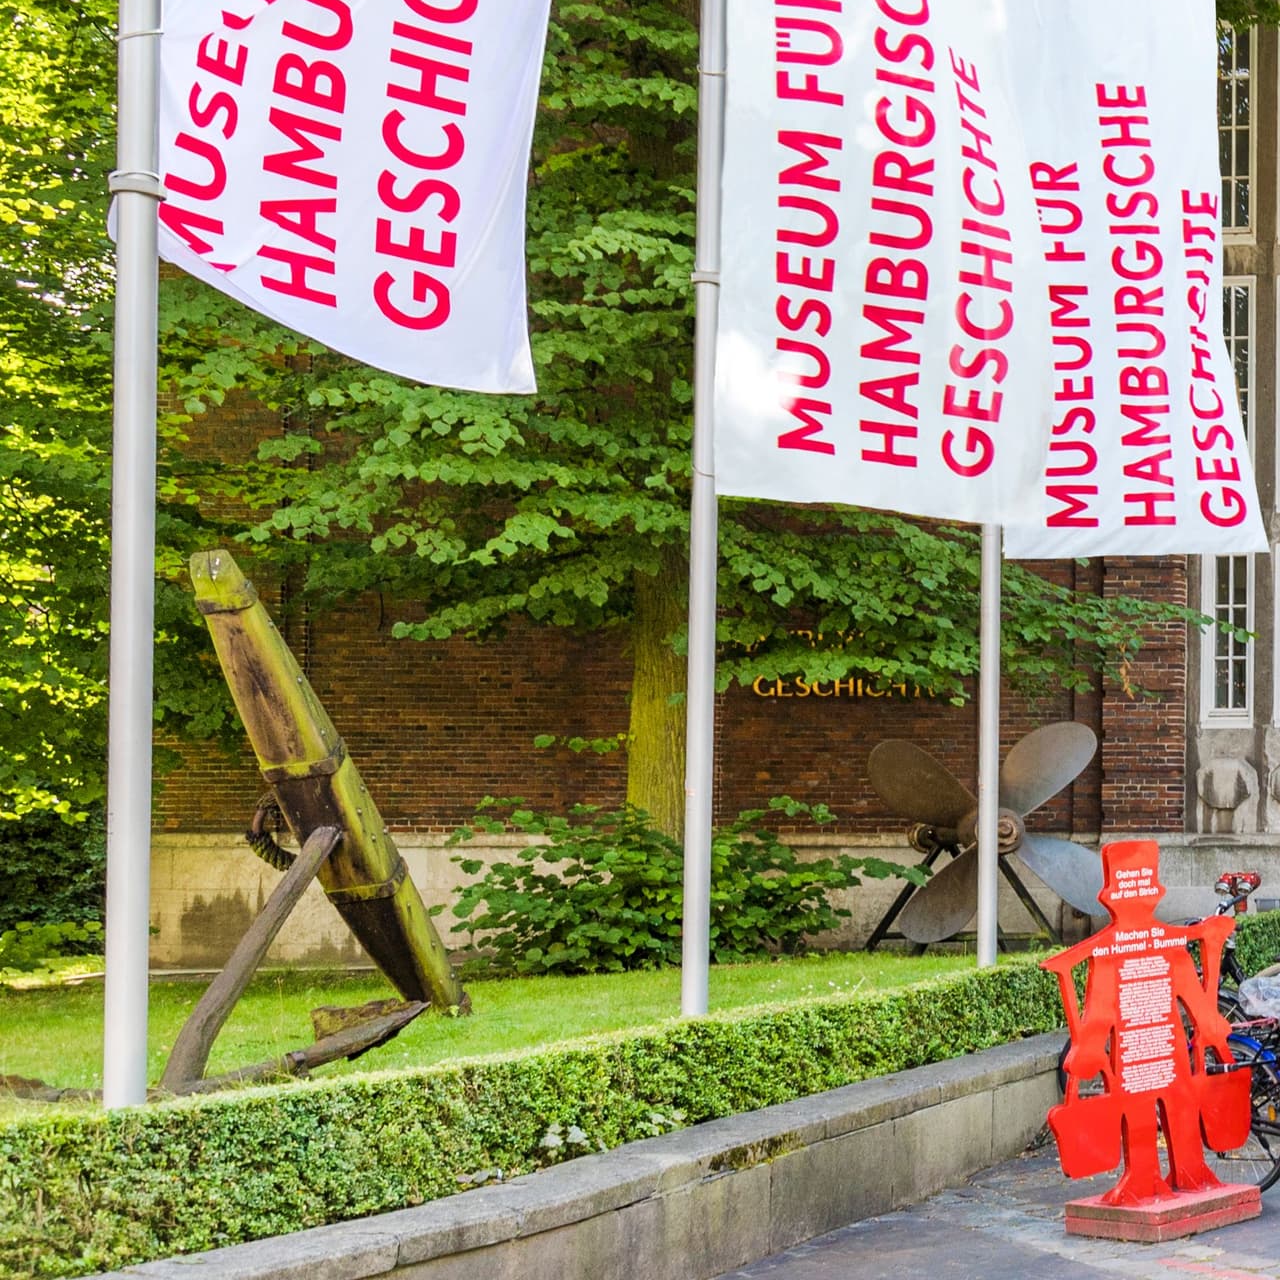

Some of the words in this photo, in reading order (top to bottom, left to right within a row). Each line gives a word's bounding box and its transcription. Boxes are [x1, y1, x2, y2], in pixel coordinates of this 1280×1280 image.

[1029, 161, 1087, 263] FÜR
[942, 46, 1016, 479] GESCHICHTE
[776, 130, 844, 457] MUSEUM
[1096, 83, 1178, 528] HAMBURGISCHE
[1045, 285, 1100, 529] MUSEUM
[753, 674, 935, 697] GESCHICH
[1116, 870, 1140, 879] Gehen
[1141, 868, 1153, 876] Sie
[1119, 880, 1136, 888] doch
[1138, 878, 1151, 886] mal
[1110, 890, 1123, 900] auf
[1124, 890, 1137, 898] den
[1092, 946, 1109, 956] den
[1111, 941, 1146, 954] Hummel
[1153, 936, 1187, 949] Bummel
[1115, 930, 1149, 942] Machen
[1151, 927, 1165, 937] Sie
